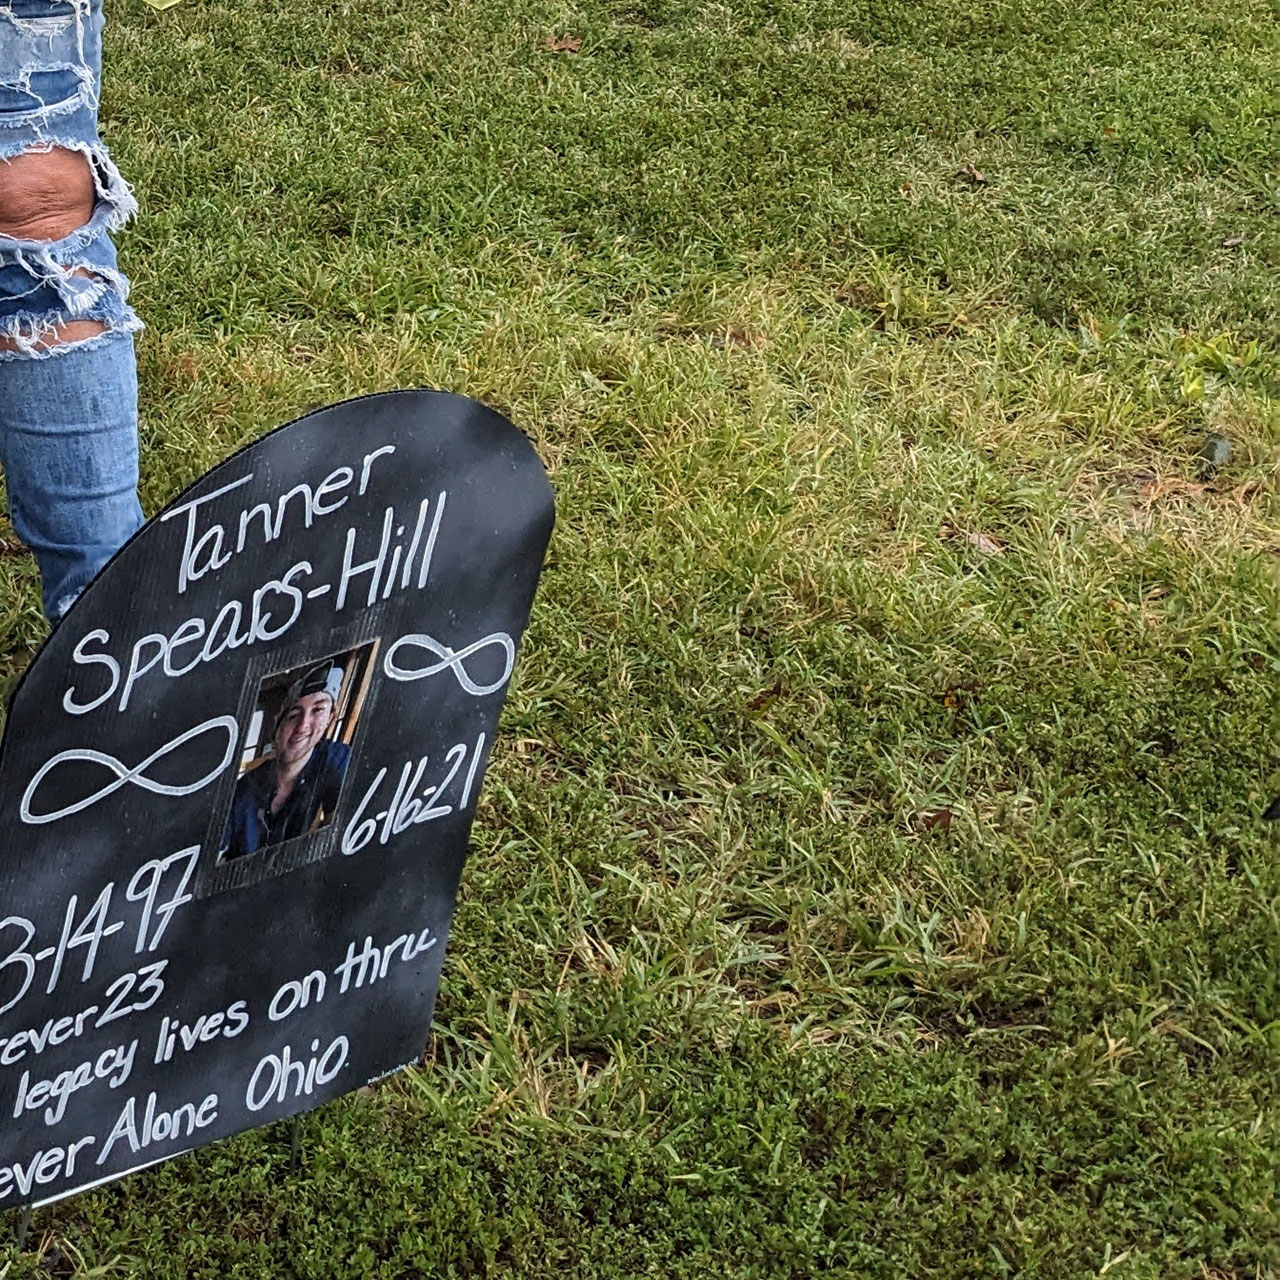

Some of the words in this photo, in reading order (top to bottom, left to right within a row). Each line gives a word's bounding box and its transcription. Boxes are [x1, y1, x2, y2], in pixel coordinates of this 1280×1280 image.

[160, 443, 397, 595] Tanner
[61, 491, 448, 717] Spears-Hill
[338, 731, 488, 859] 6-16-21
[12, 1042, 141, 1133] legacy
[154, 997, 251, 1064] lives
[266, 966, 328, 1023] on
[332, 927, 438, 995] thru
[92, 961, 167, 1033] 23
[95, 1089, 220, 1167] Alone
